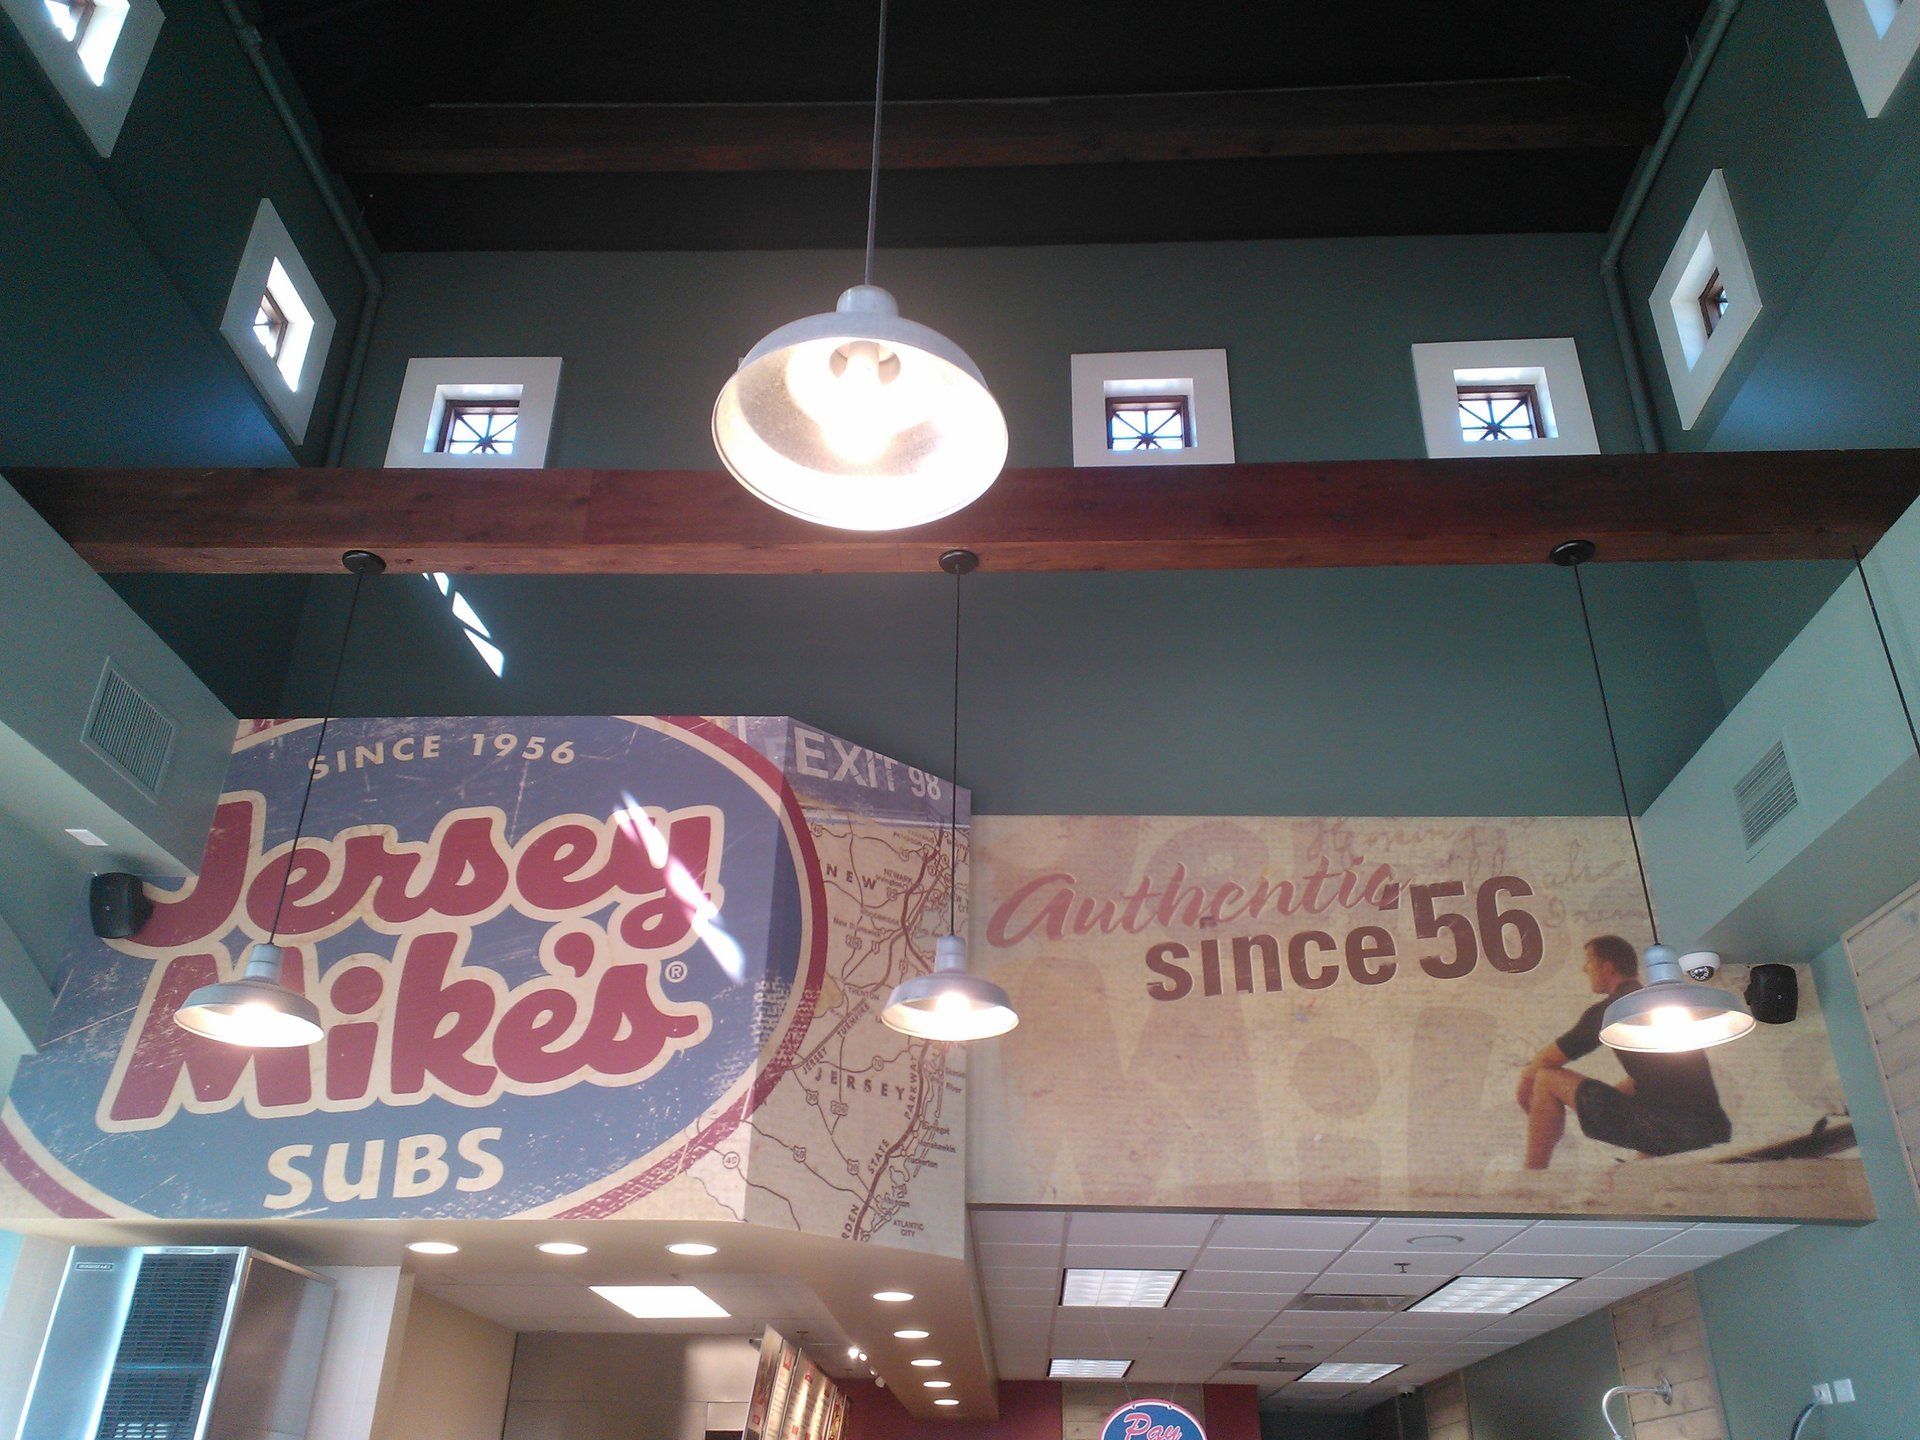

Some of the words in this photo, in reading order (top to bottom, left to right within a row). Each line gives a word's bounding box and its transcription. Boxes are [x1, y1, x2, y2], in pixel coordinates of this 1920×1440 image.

[308, 732, 442, 781] SINCE
[471, 733, 577, 765] 1956
[794, 726, 899, 792] EXIT
[908, 766, 942, 800] 98
[122, 790, 725, 956] Jersey
[986, 854, 1414, 949] Authentic
[1145, 917, 1398, 1001] since
[98, 923, 713, 1132] Mike's
[263, 1127, 504, 1210] SUBS
